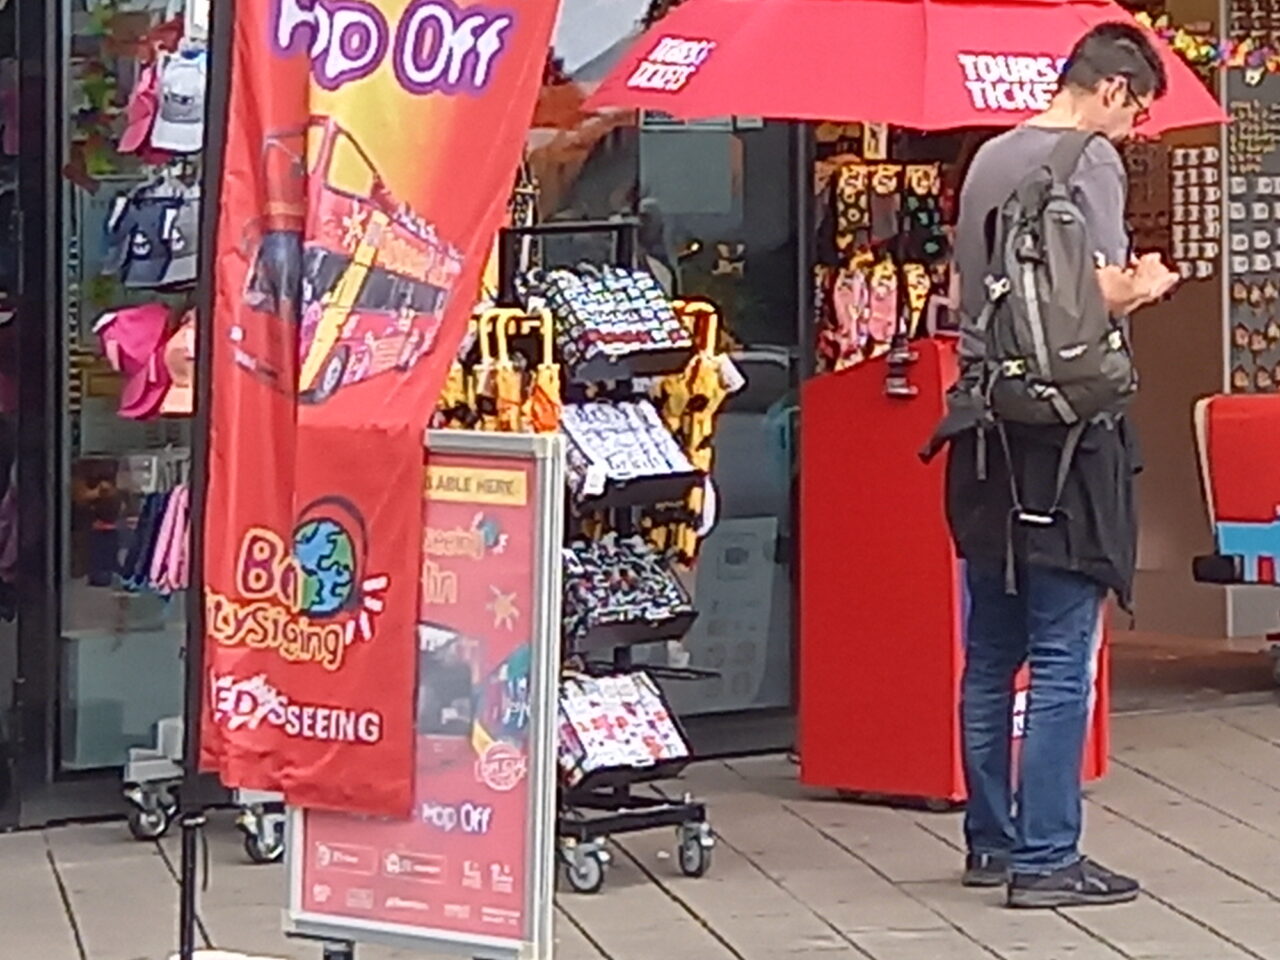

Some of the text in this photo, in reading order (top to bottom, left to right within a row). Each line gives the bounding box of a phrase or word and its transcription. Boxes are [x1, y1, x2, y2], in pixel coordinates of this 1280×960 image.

[403, 3, 510, 87] Off
[957, 53, 1059, 82] TOURS
[965, 80, 1059, 110] TICKE
[460, 801, 492, 834] Off
